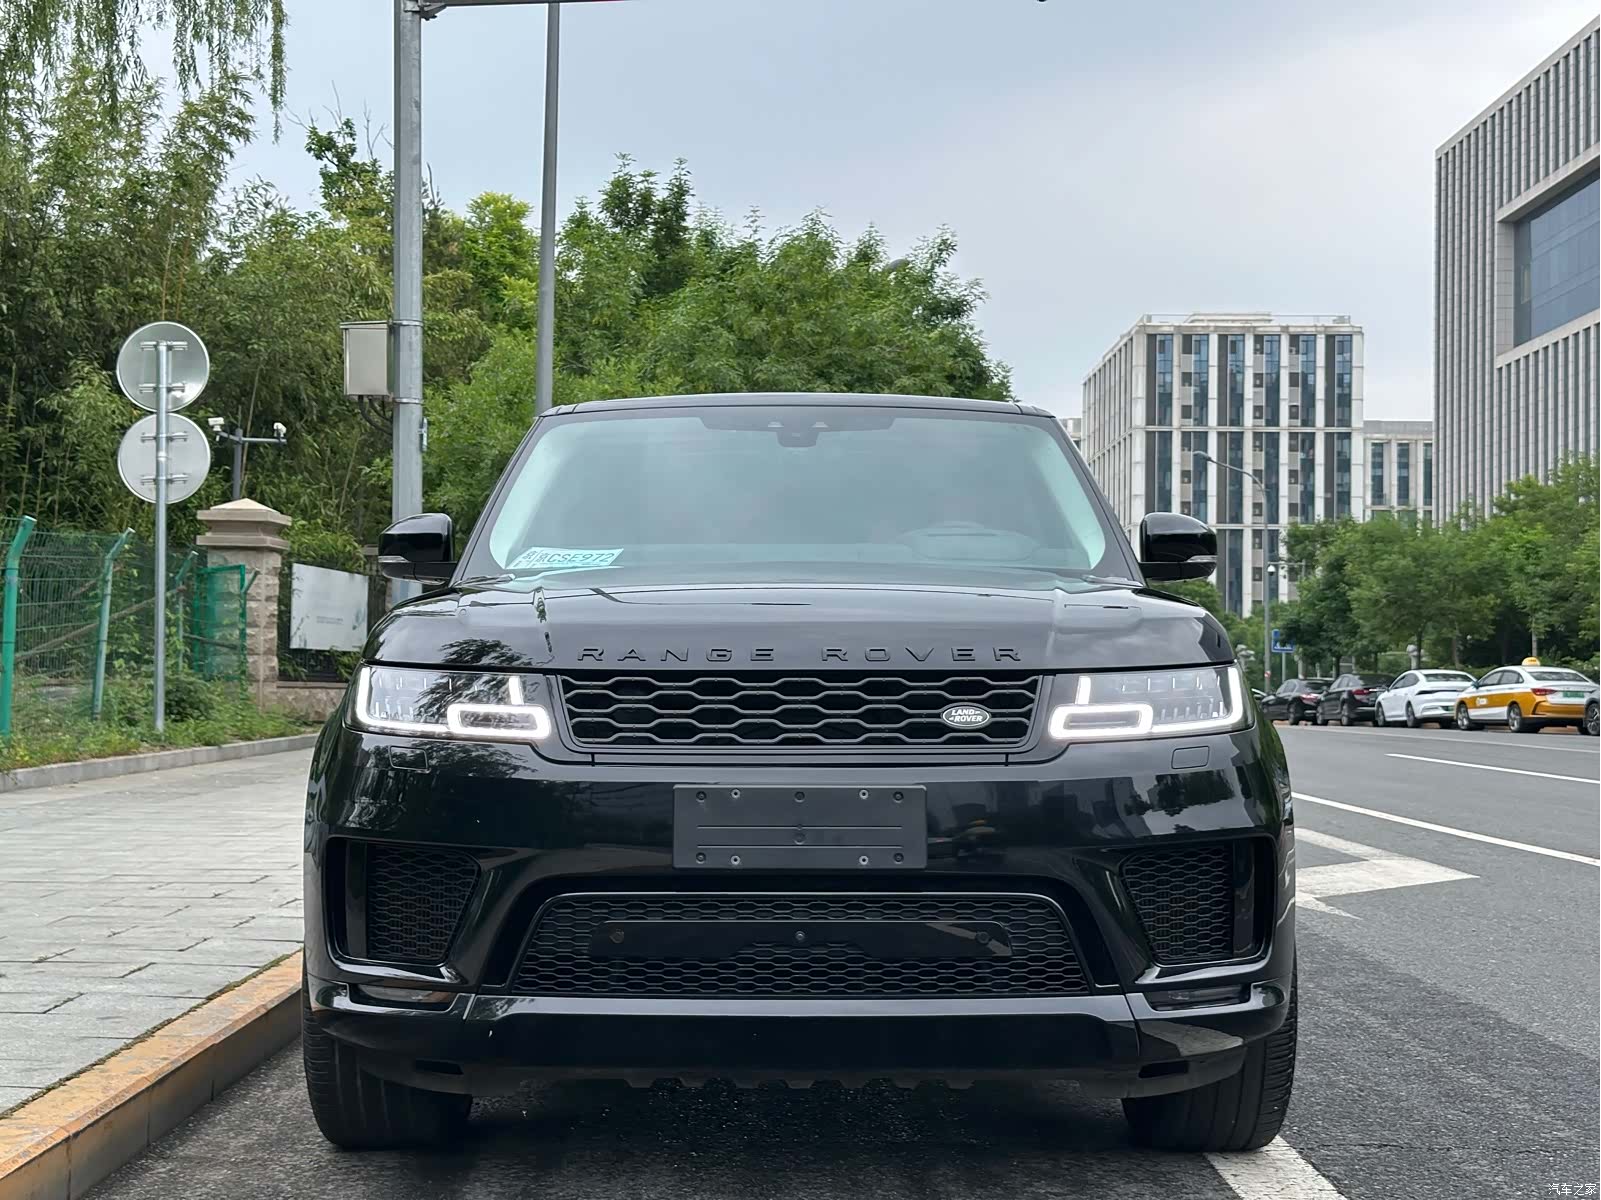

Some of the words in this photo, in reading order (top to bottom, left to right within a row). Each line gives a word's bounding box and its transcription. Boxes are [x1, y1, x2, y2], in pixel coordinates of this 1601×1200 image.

[577, 647, 775, 662] RANGE
[820, 647, 1022, 662] ROVER
[951, 708, 975, 716] LAND
[953, 715, 983, 723] ROVER
